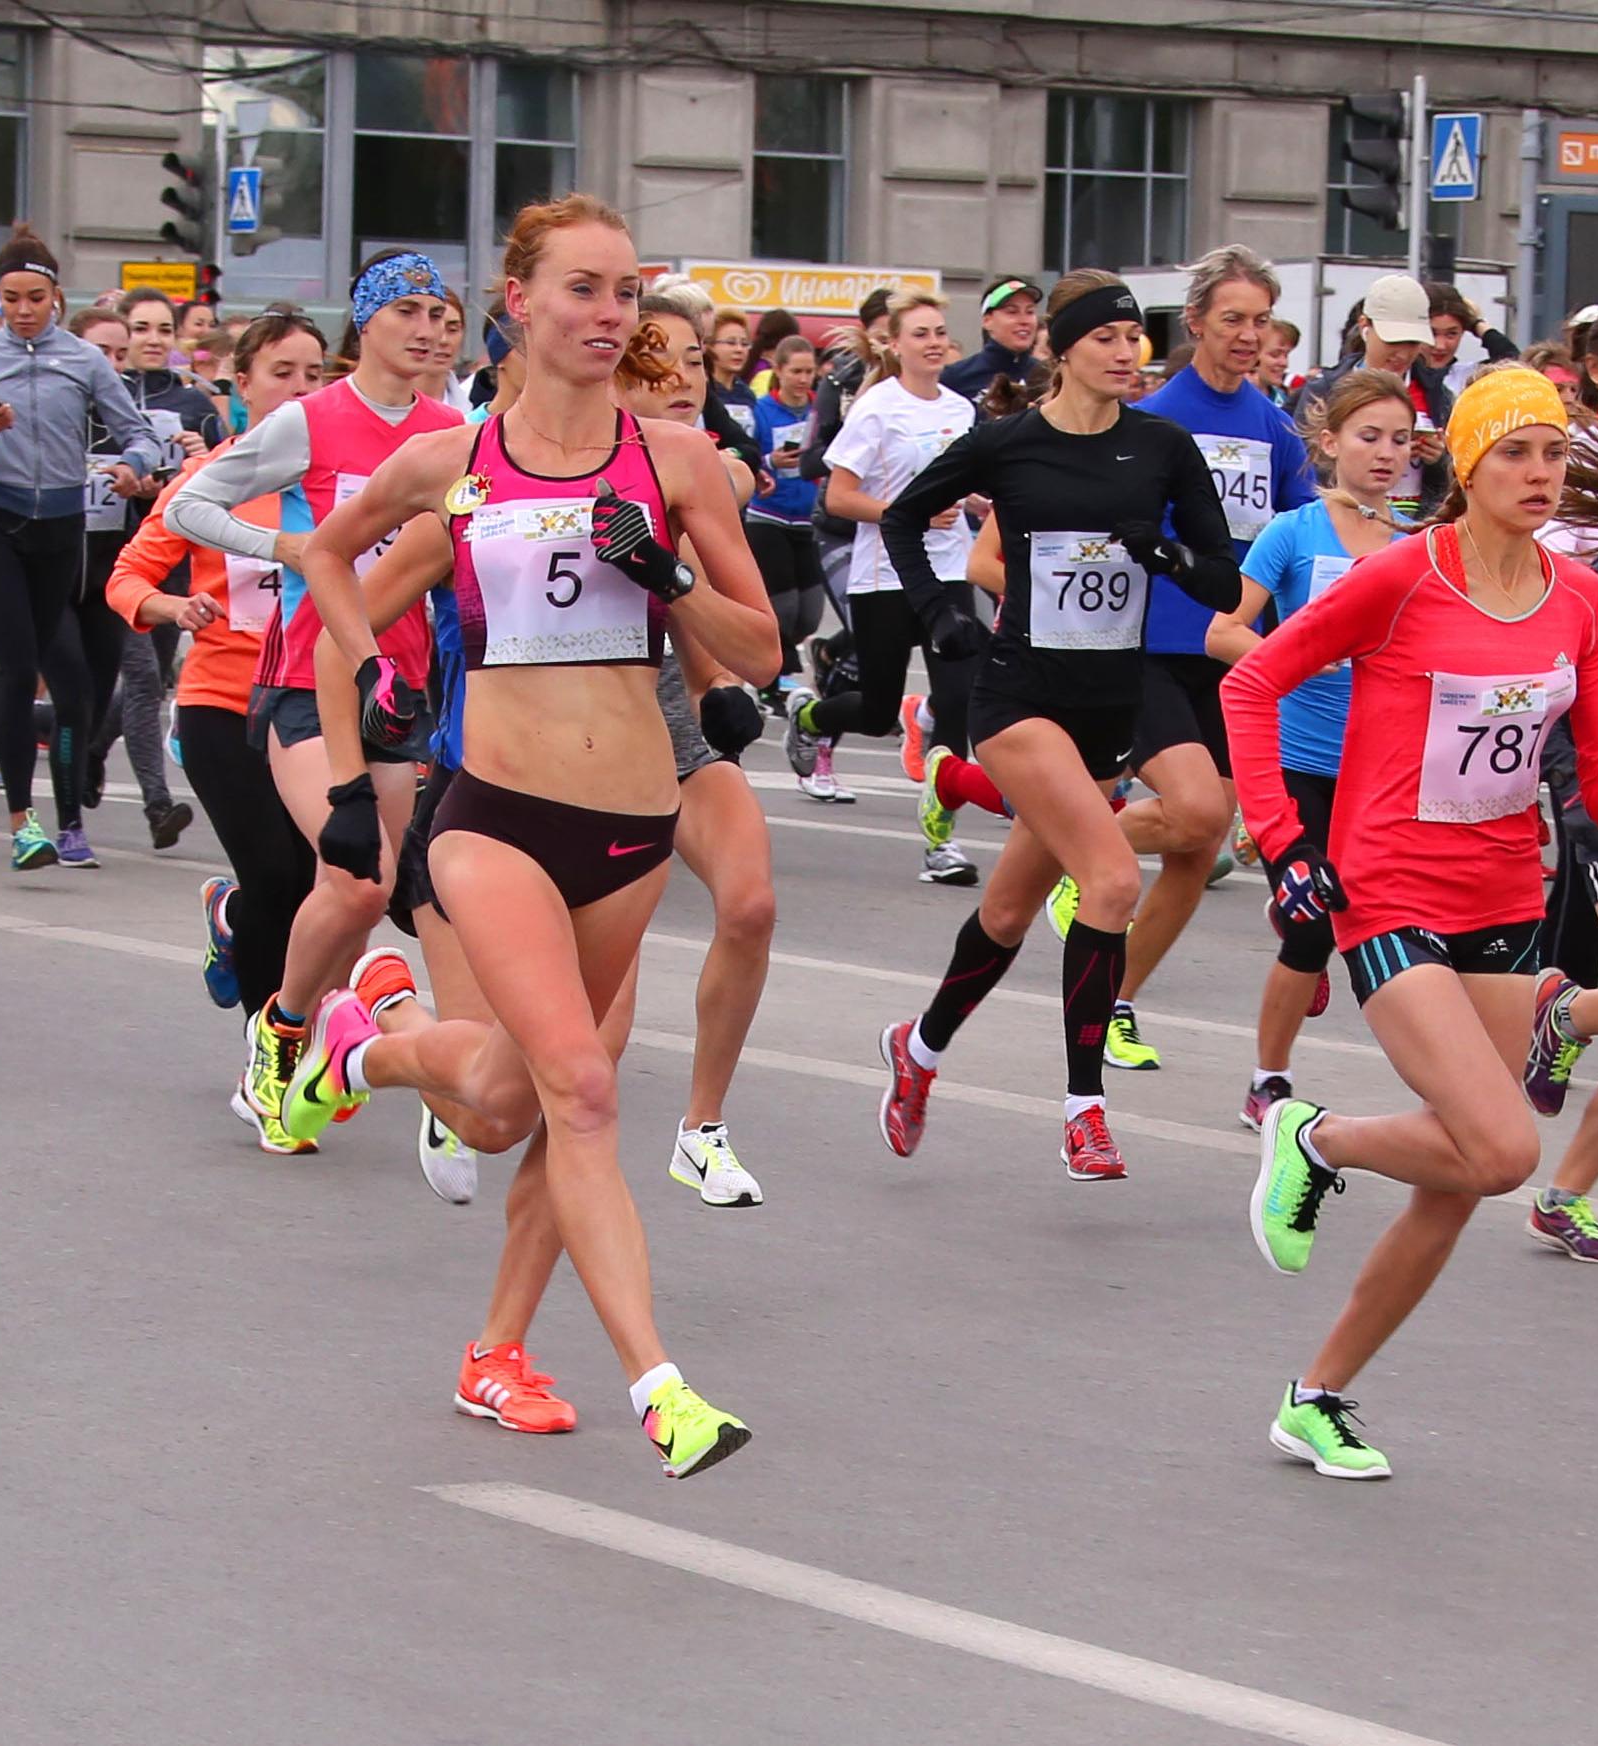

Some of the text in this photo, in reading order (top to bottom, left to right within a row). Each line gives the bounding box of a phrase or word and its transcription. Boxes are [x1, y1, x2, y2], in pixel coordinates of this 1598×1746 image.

[545, 551, 583, 608] 5
[1052, 571, 1131, 612] 789
[1457, 716, 1547, 775] 787
